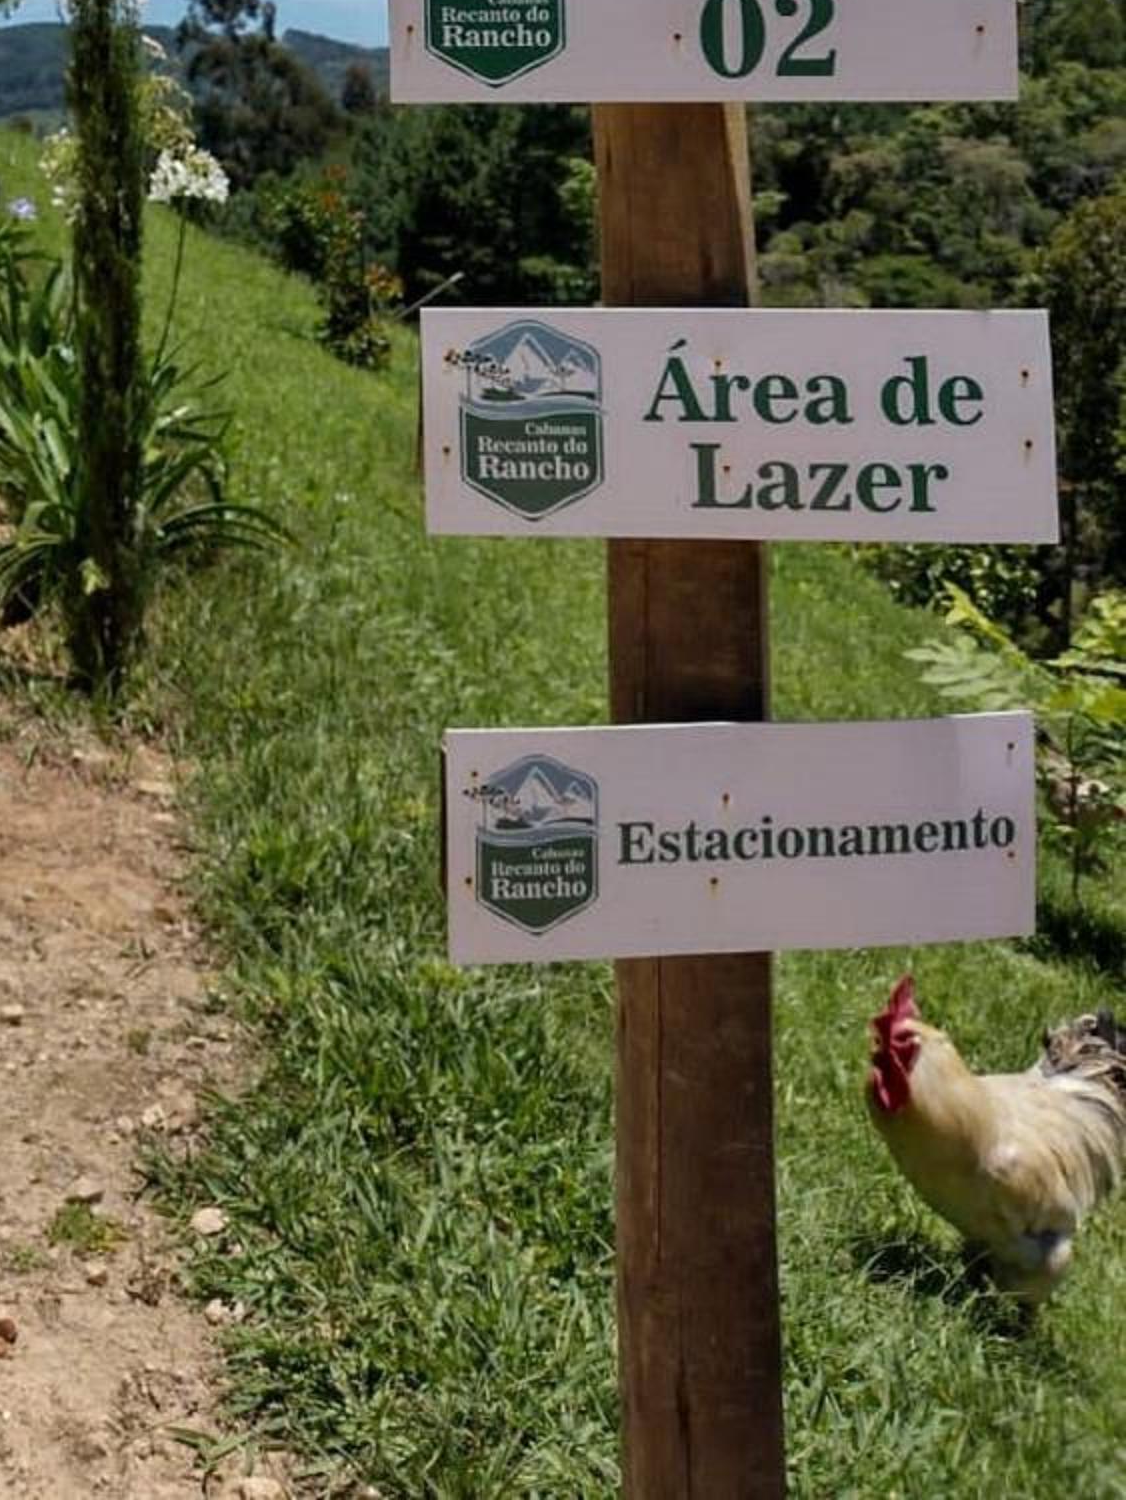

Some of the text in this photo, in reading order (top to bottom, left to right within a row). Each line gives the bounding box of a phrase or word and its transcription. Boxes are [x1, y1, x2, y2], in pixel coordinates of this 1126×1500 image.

[441, 6, 550, 22] Recanto do
[442, 23, 552, 47] Rancho
[642, 338, 984, 427] Área de
[477, 436, 588, 454] Recanto do
[478, 454, 590, 480] Rancho
[689, 442, 949, 514] Lazer
[617, 807, 1016, 865] Estacionamento
[564, 860, 586, 875] do
[492, 876, 587, 899] Rancho
